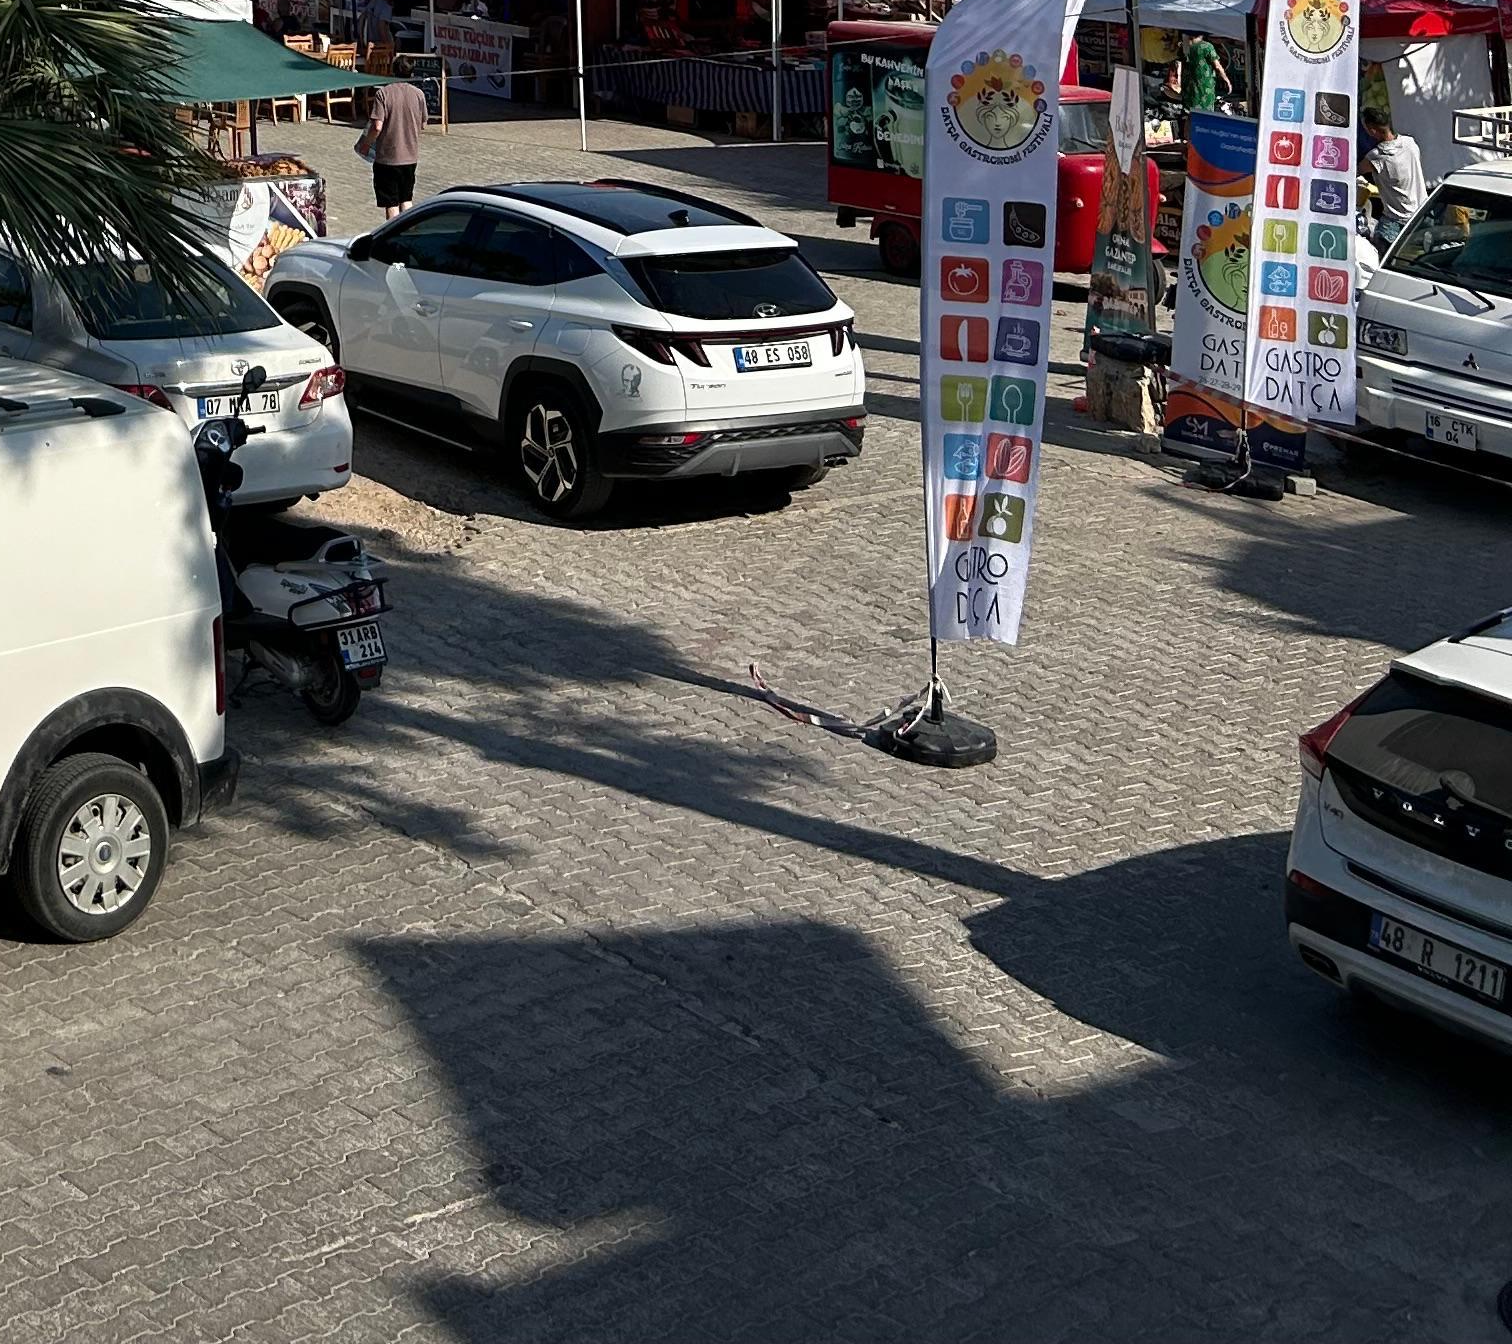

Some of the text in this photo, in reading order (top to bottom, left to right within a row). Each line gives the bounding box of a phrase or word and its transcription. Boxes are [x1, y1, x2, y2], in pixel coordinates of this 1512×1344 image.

[940, 105, 1054, 166] DATÇA GASTRONOMİ FESTİVALİ
[744, 345, 809, 365] 48 ES 058
[1266, 347, 1342, 382] GASTRO
[206, 398, 222, 415] 07
[262, 393, 277, 411] 78
[1266, 376, 1342, 412] DATÇA
[1429, 415, 1474, 437] 16 CTK
[1445, 431, 1459, 444] 04
[339, 625, 378, 646] 31 ARB
[359, 641, 382, 659] 214
[1381, 920, 1499, 997] 48 R 1211
